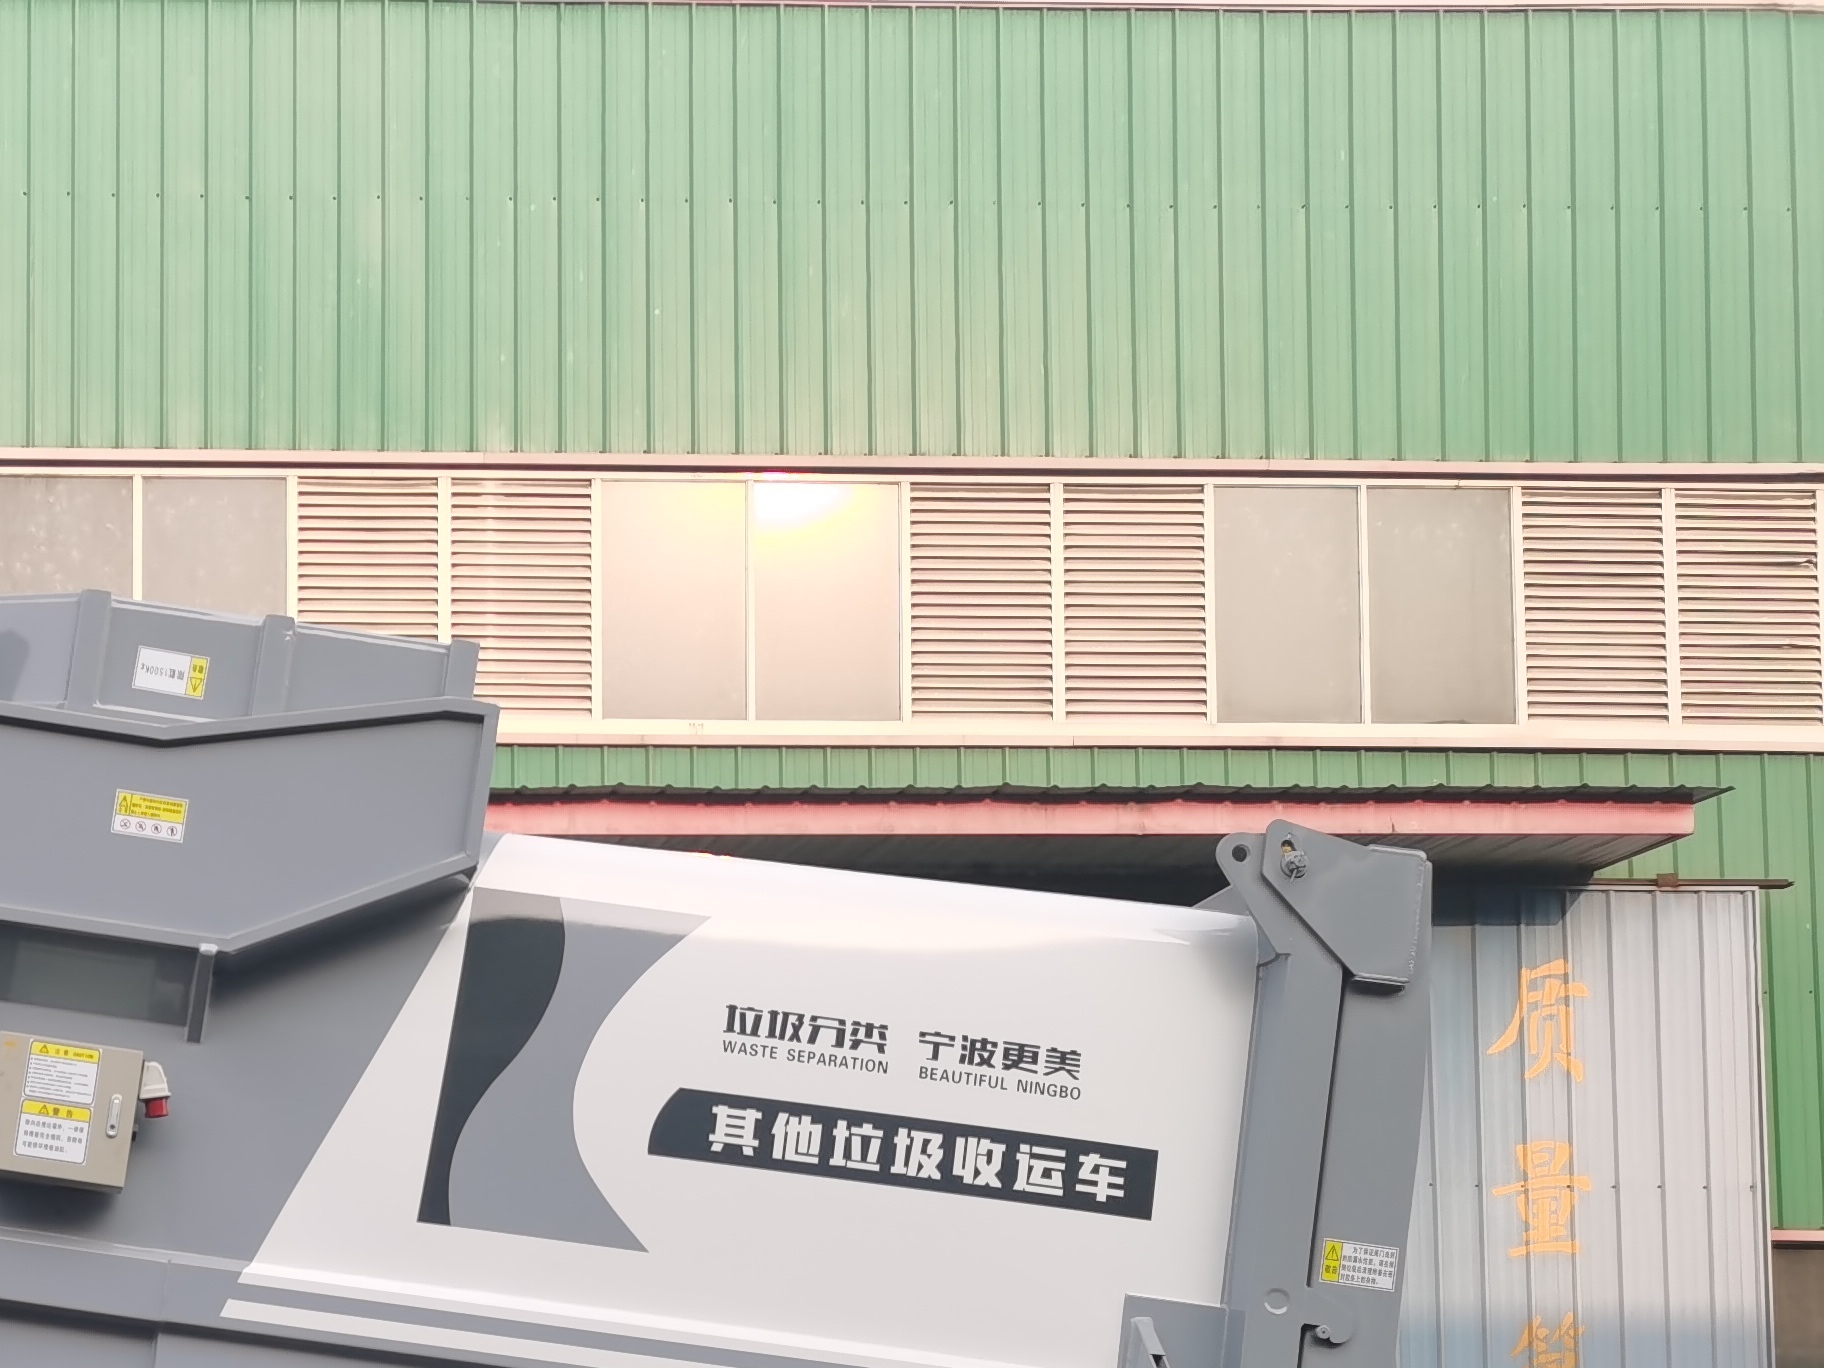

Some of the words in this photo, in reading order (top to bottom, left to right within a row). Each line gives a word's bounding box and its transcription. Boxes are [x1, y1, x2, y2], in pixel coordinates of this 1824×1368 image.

[722, 1003, 889, 1055] 垃圾分类
[722, 1039, 778, 1060] WASTE
[786, 1048, 889, 1075] SEPARATION
[918, 1030, 1082, 1081] 宁波更美
[918, 1065, 1008, 1091] BEAUTIFUL
[1016, 1079, 1081, 1101] NINGBO
[708, 1104, 1128, 1203] 其他垃圾收运车
